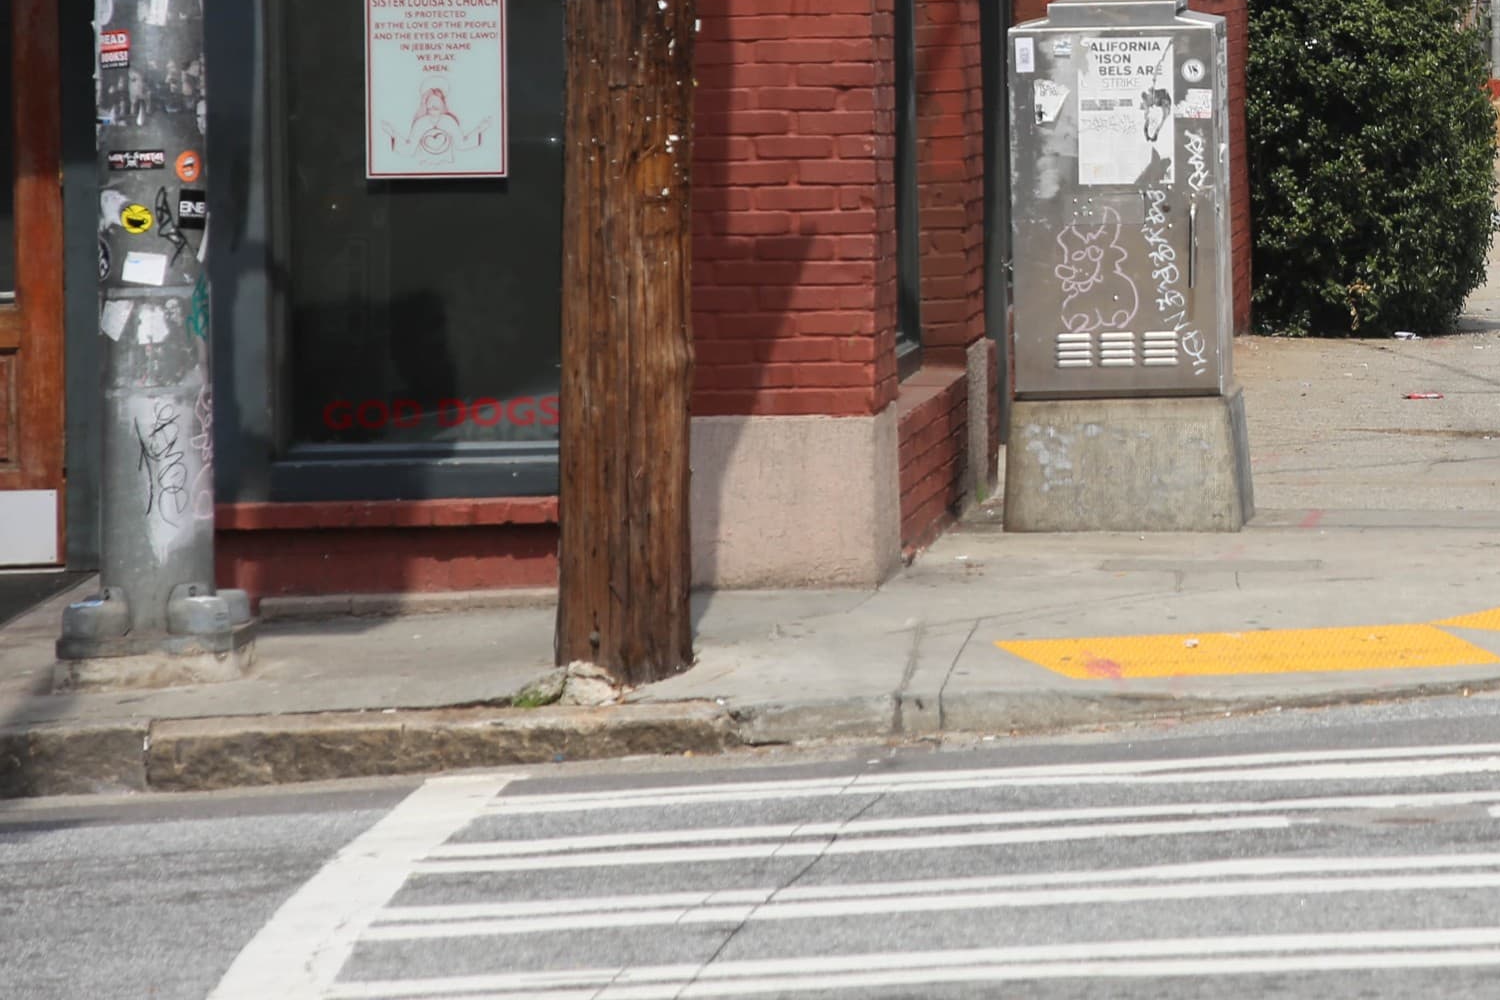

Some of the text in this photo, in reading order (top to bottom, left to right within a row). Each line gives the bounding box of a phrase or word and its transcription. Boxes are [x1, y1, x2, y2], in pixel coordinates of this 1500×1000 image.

[405, 10, 467, 18] IS PROTECTED
[374, 22, 386, 30] BY
[407, 21, 429, 29] LOVE
[431, 21, 443, 29] OF
[445, 21, 461, 29] THE
[374, 32, 393, 40] AND
[400, 43, 410, 51] IN
[446, 42, 471, 50] NAME
[1089, 41, 1161, 52] ALIFORNIA
[416, 53, 431, 61] WE
[1094, 53, 1132, 65] ISON
[1098, 65, 1163, 76] BELS ARE
[1102, 77, 1141, 89] STRIKE
[322, 396, 560, 431] GOD DOGS
